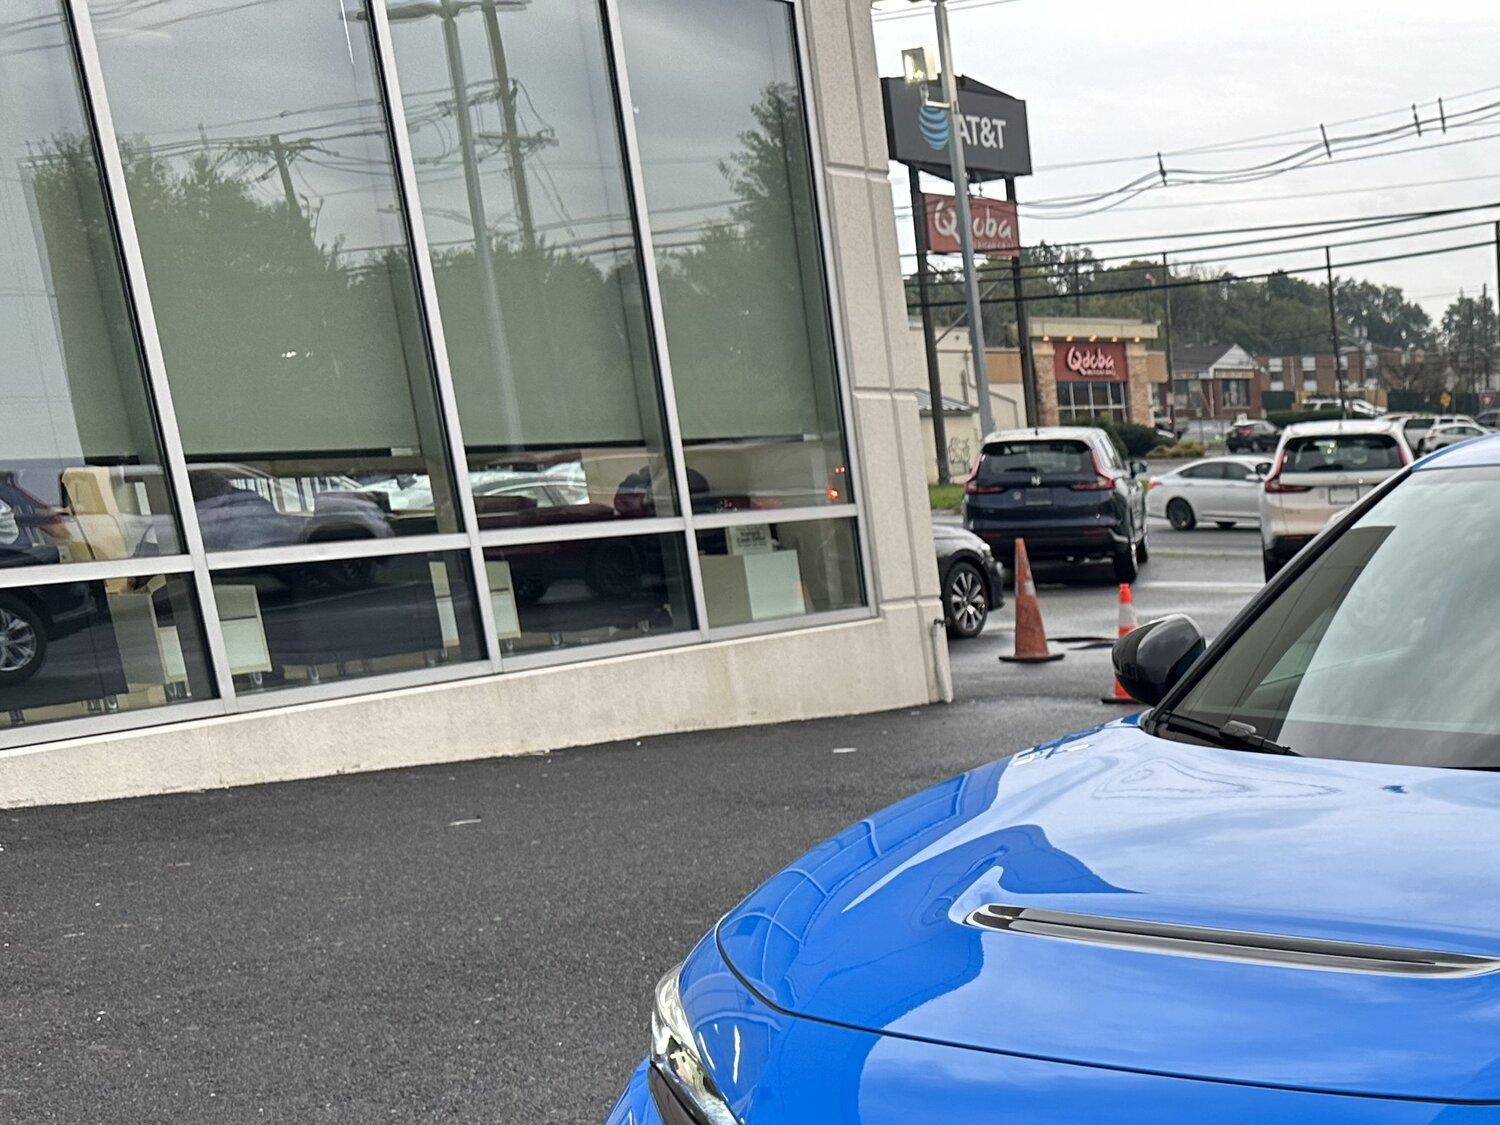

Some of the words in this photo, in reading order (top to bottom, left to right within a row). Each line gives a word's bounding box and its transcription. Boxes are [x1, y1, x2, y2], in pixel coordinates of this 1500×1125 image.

[956, 113, 1006, 149] AT&T
[935, 201, 1014, 244] Qoba
[1067, 346, 1116, 376] Qdoba
